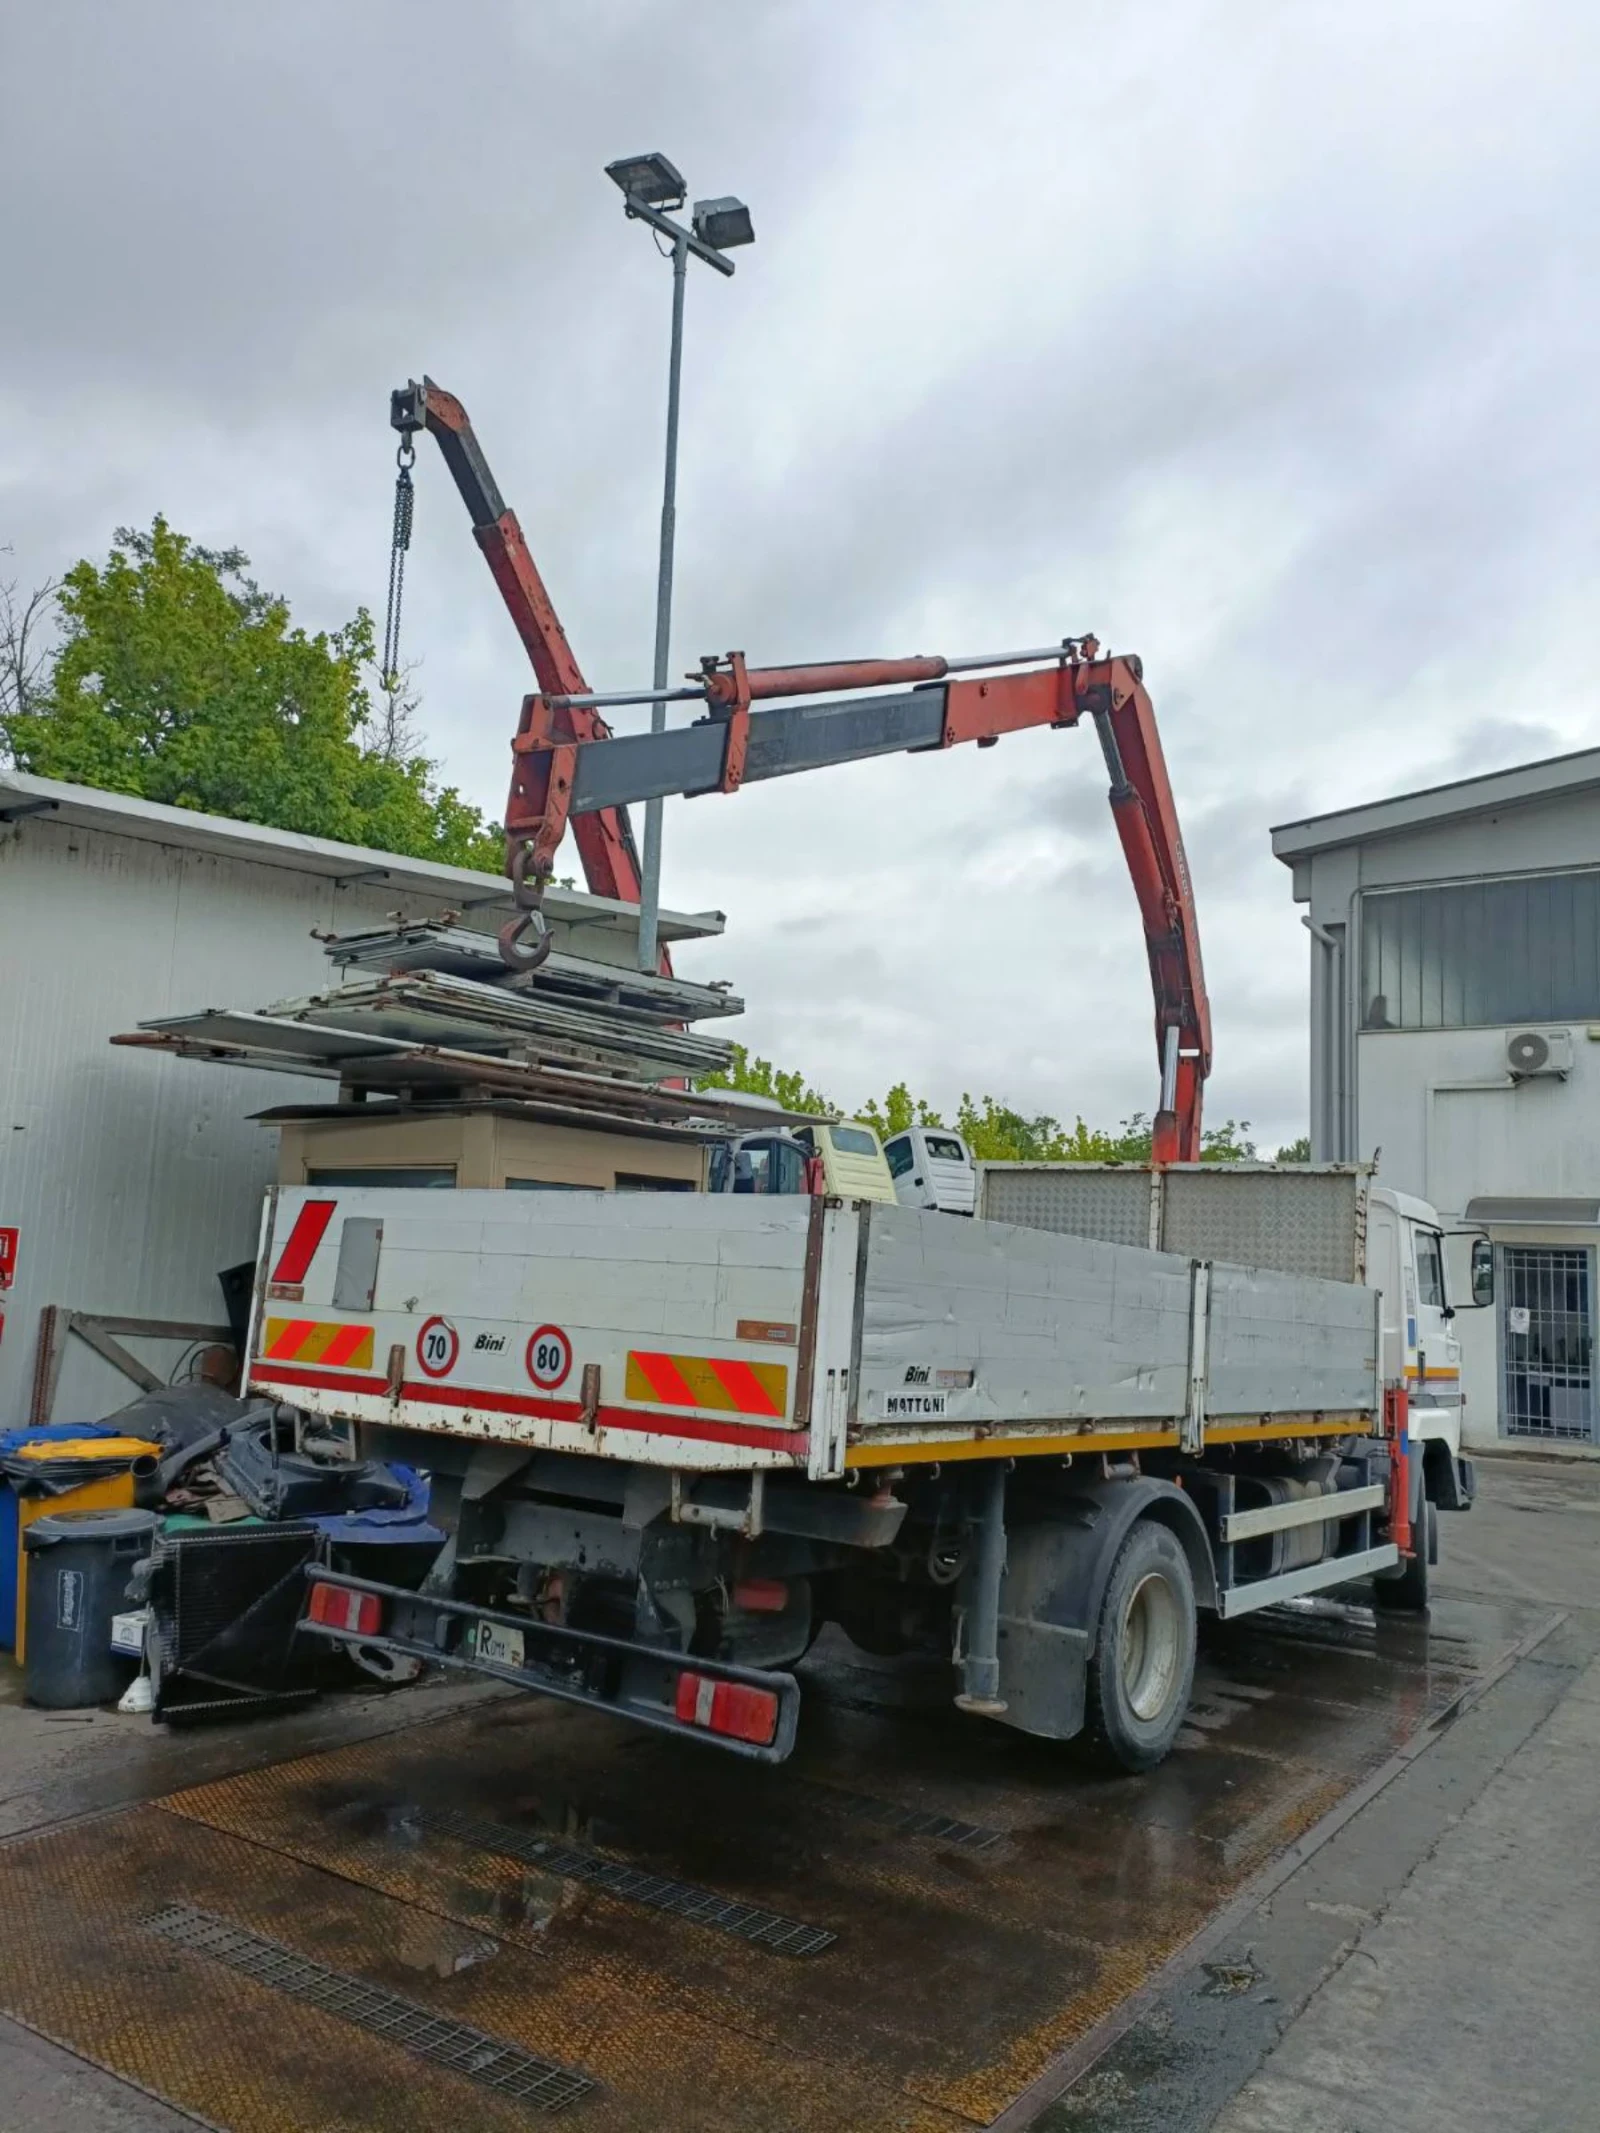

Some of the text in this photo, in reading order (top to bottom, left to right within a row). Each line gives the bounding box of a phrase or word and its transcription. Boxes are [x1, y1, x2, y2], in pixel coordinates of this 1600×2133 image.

[428, 1335, 446, 1360] 70
[474, 1334, 506, 1351] Bini
[537, 1344, 560, 1371] 80
[904, 1365, 931, 1382] Bini
